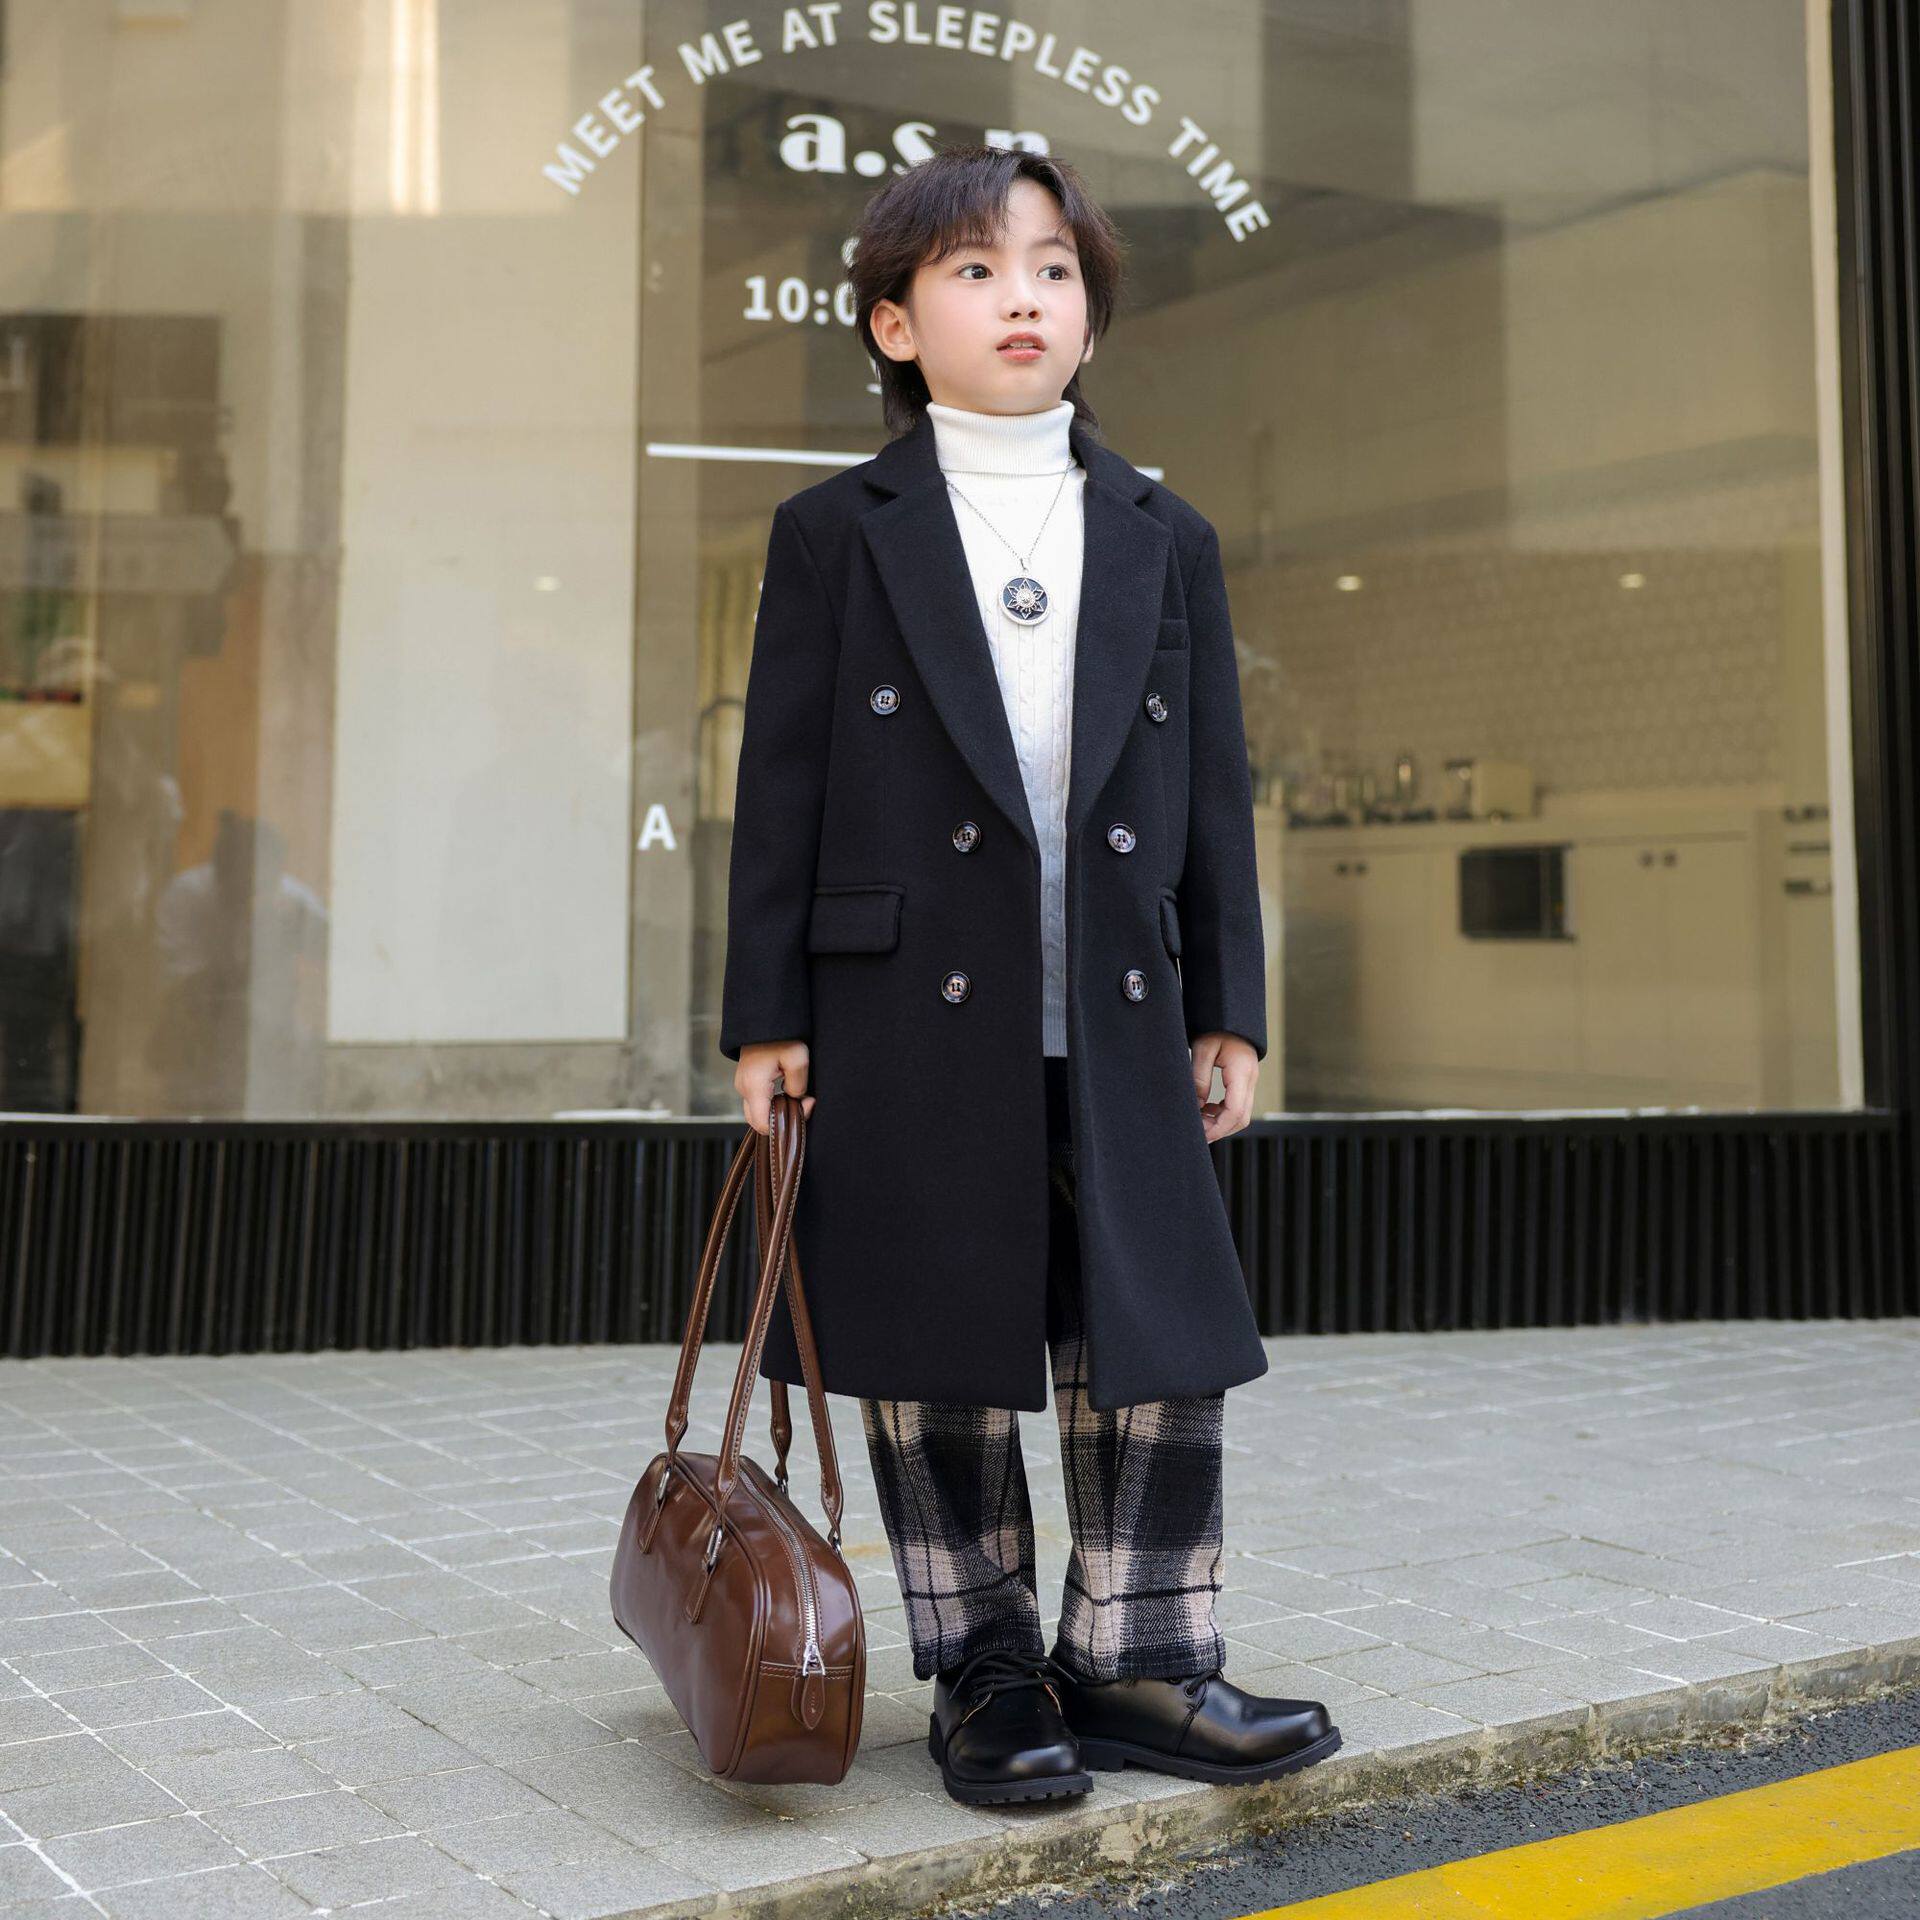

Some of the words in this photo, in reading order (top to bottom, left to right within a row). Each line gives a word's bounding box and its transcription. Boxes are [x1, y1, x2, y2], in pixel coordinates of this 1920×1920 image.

[541, 66, 665, 196] MEET
[678, 20, 762, 84] ME
[782, 2, 842, 53] AT
[869, 0, 1161, 127] SLEEPLESS
[1168, 117, 1271, 243] TIME
[637, 803, 678, 851] A
